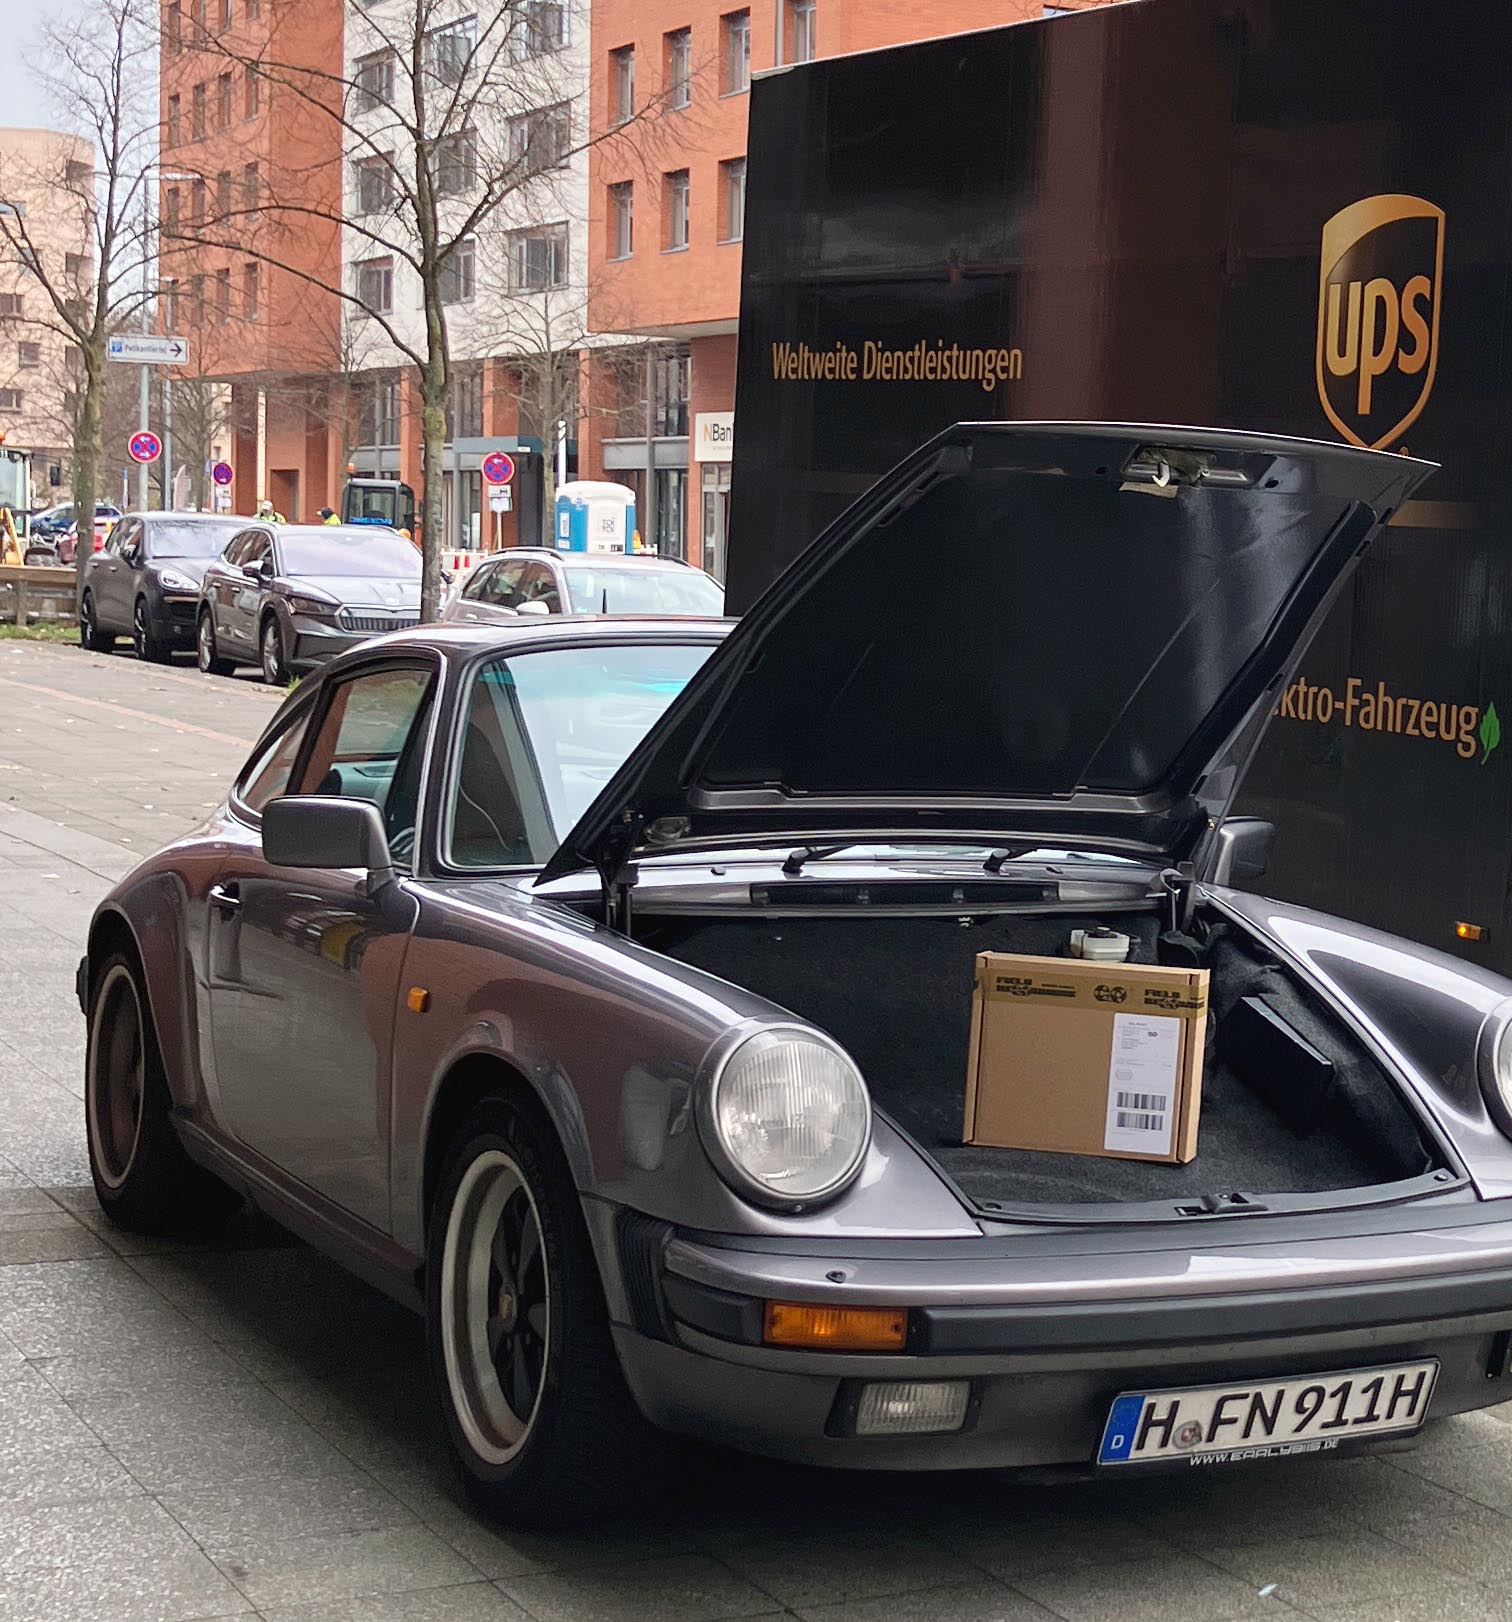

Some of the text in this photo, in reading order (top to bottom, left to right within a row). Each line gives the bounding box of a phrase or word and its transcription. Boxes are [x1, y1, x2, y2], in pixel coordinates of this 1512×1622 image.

[773, 340, 1022, 392] Weltweite Dienstleistungen
[1326, 275, 1431, 415] ups
[704, 423, 732, 442] NBan
[1273, 677, 1479, 759] ktro-Fahrzeug
[1110, 1370, 1428, 1451] D H FN 911H
